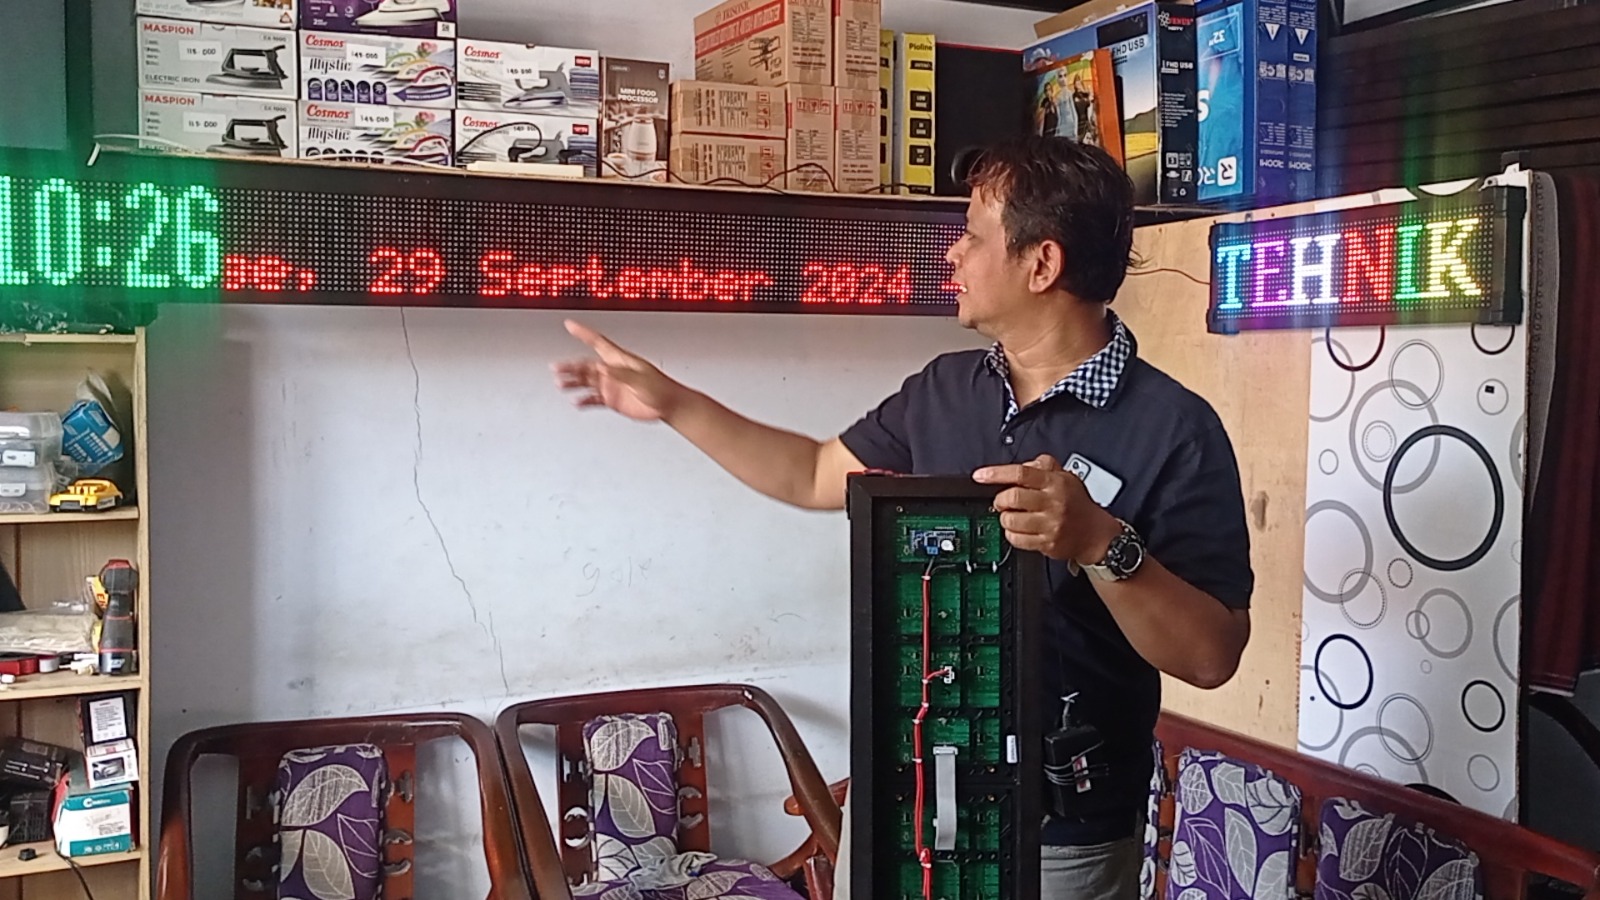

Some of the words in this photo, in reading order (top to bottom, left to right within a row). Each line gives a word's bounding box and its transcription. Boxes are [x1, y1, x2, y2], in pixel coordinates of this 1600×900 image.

[143, 23, 194, 35] MASPION
[305, 34, 345, 48] Cosmos
[1128, 38, 1145, 51] USB
[464, 46, 500, 59] Cosmos
[145, 74, 180, 82] ELECTRIC
[617, 94, 659, 103] PROCESSOR
[637, 89, 657, 97] FOOD
[144, 95, 195, 106] MASPION
[307, 104, 350, 119] Cosmos
[463, 116, 499, 128] Cosmos
[0, 175, 219, 289] 10:26
[1216, 217, 1482, 310] TEHNIK
[368, 247, 445, 294] 29
[479, 250, 774, 300] September
[801, 263, 912, 304] 2024
